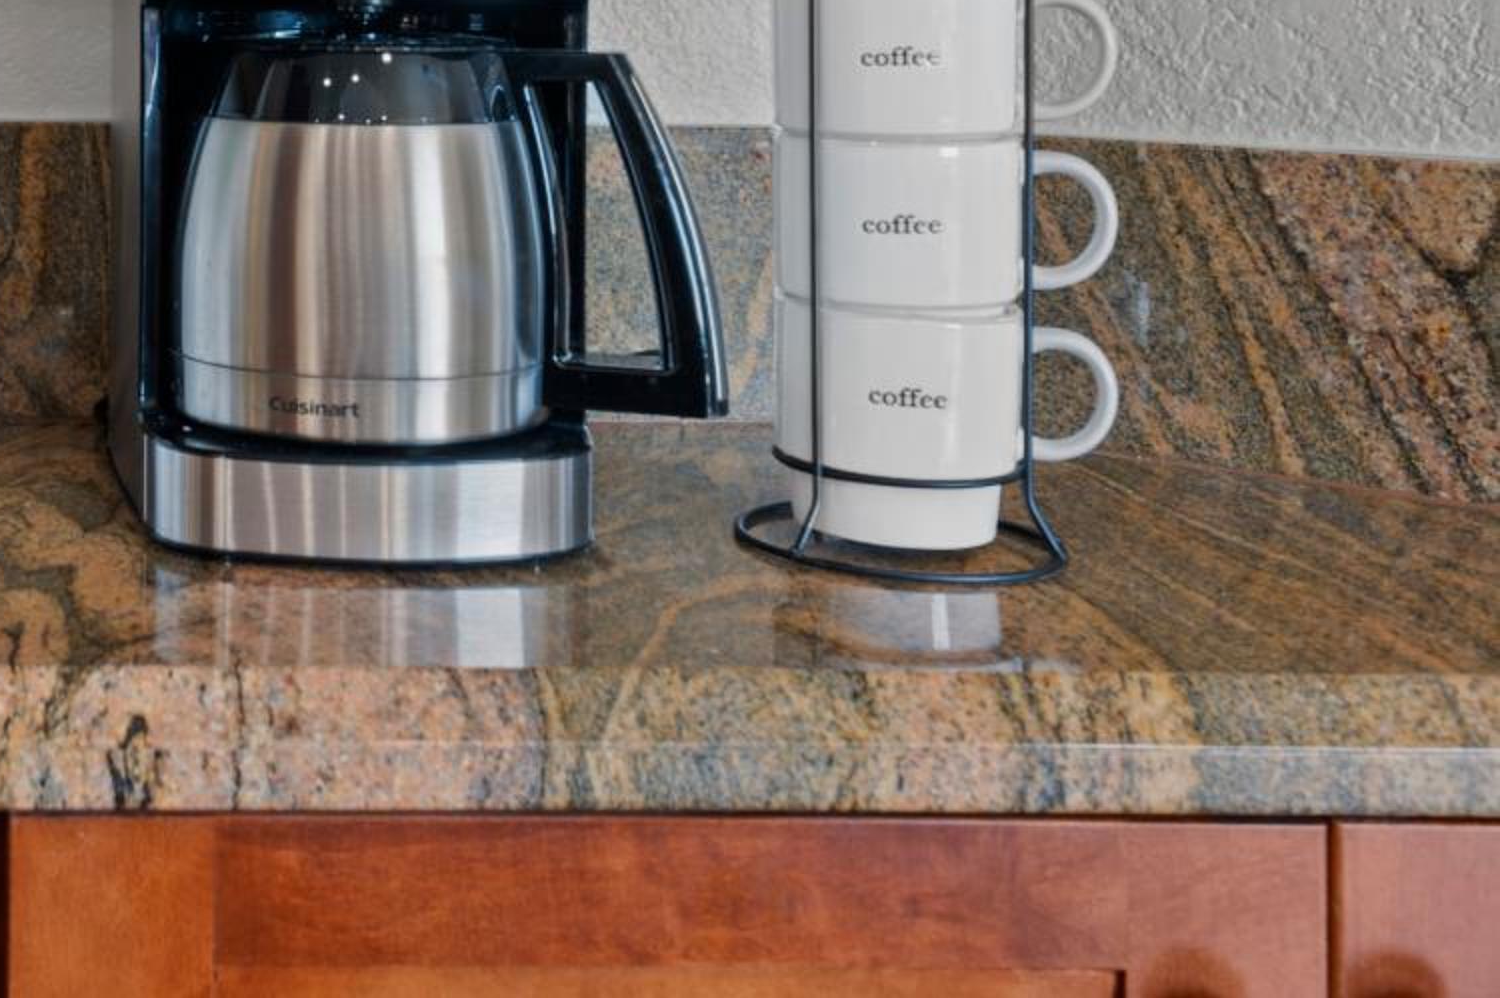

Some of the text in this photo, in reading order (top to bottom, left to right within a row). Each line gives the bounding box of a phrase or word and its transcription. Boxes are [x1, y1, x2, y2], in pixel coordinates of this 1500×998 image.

[860, 45, 941, 69] coffee
[861, 214, 942, 236] coffee
[268, 396, 359, 418] Cuisinart
[868, 386, 948, 411] coffee
